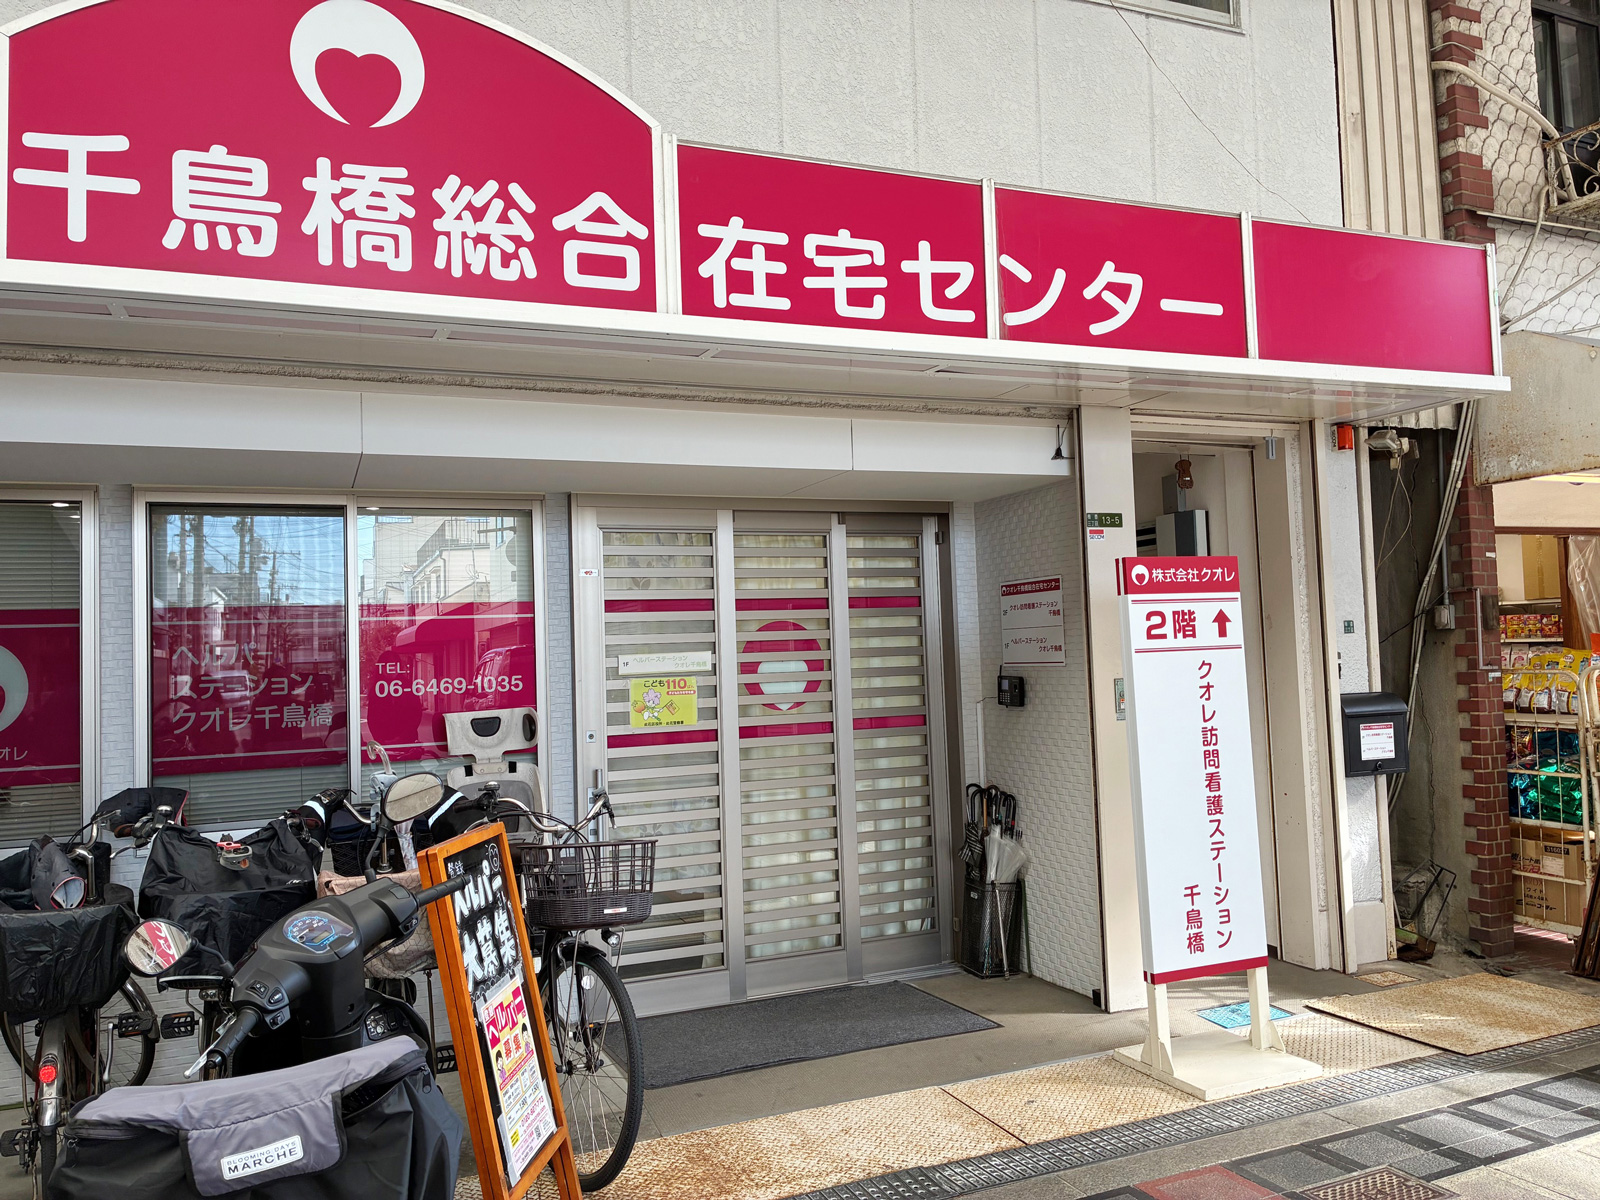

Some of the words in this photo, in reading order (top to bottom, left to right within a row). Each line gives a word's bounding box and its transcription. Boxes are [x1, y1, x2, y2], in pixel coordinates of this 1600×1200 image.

[1102, 516, 1120, 524] 13-5
[1151, 567, 1236, 583] 株式会社クオレ
[1145, 609, 1197, 640] 2階
[172, 642, 273, 666] ヘルパー
[633, 655, 688, 664] ヘルパーステーション
[674, 661, 708, 669] クオレ千鳥橋
[375, 662, 410, 675] TEL:
[172, 673, 313, 700] ステーション
[375, 675, 523, 698] 06-6469-1035
[172, 702, 333, 734] クオレ千鳥橋
[1197, 660, 1232, 949] クオレ訪問看護ステーション
[1183, 884, 1205, 955] 千鳥橋
[463, 907, 517, 993] 大募集
[488, 995, 522, 1040] ヘルパー
[503, 1033, 522, 1061] 募集
[227, 1149, 271, 1166] BLOOMING
[274, 1141, 296, 1152] DAYS
[228, 1147, 298, 1175] MARCHE
